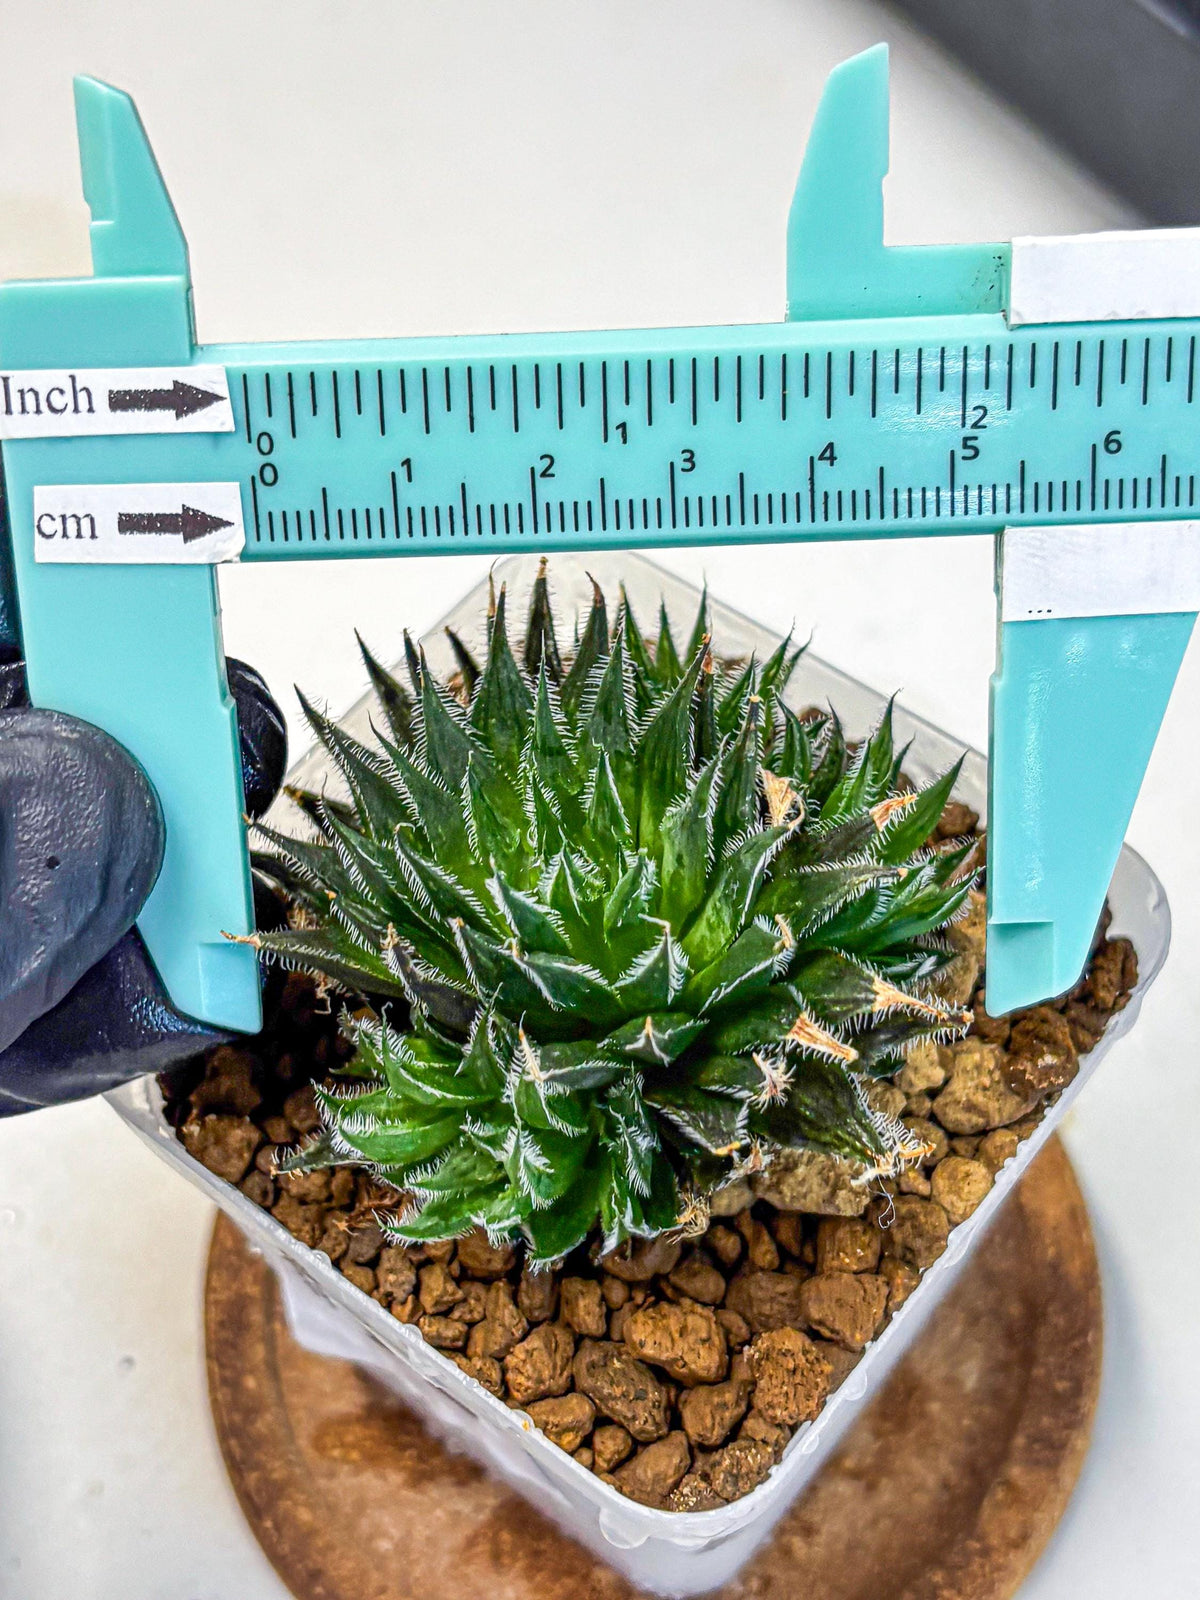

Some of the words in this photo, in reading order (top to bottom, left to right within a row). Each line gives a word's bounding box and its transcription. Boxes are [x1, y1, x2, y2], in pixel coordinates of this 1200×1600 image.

[1, 374, 95, 416] Inch
[256, 431, 274, 456] 0
[615, 421, 628, 445] 1
[970, 405, 988, 429] 2
[259, 462, 279, 487] 0
[401, 458, 413, 483] 1
[539, 454, 556, 478] 2
[680, 449, 696, 473] 3
[817, 441, 838, 467] 4
[961, 436, 980, 461] 5
[1103, 430, 1123, 455] 6
[36, 512, 98, 540] cm
